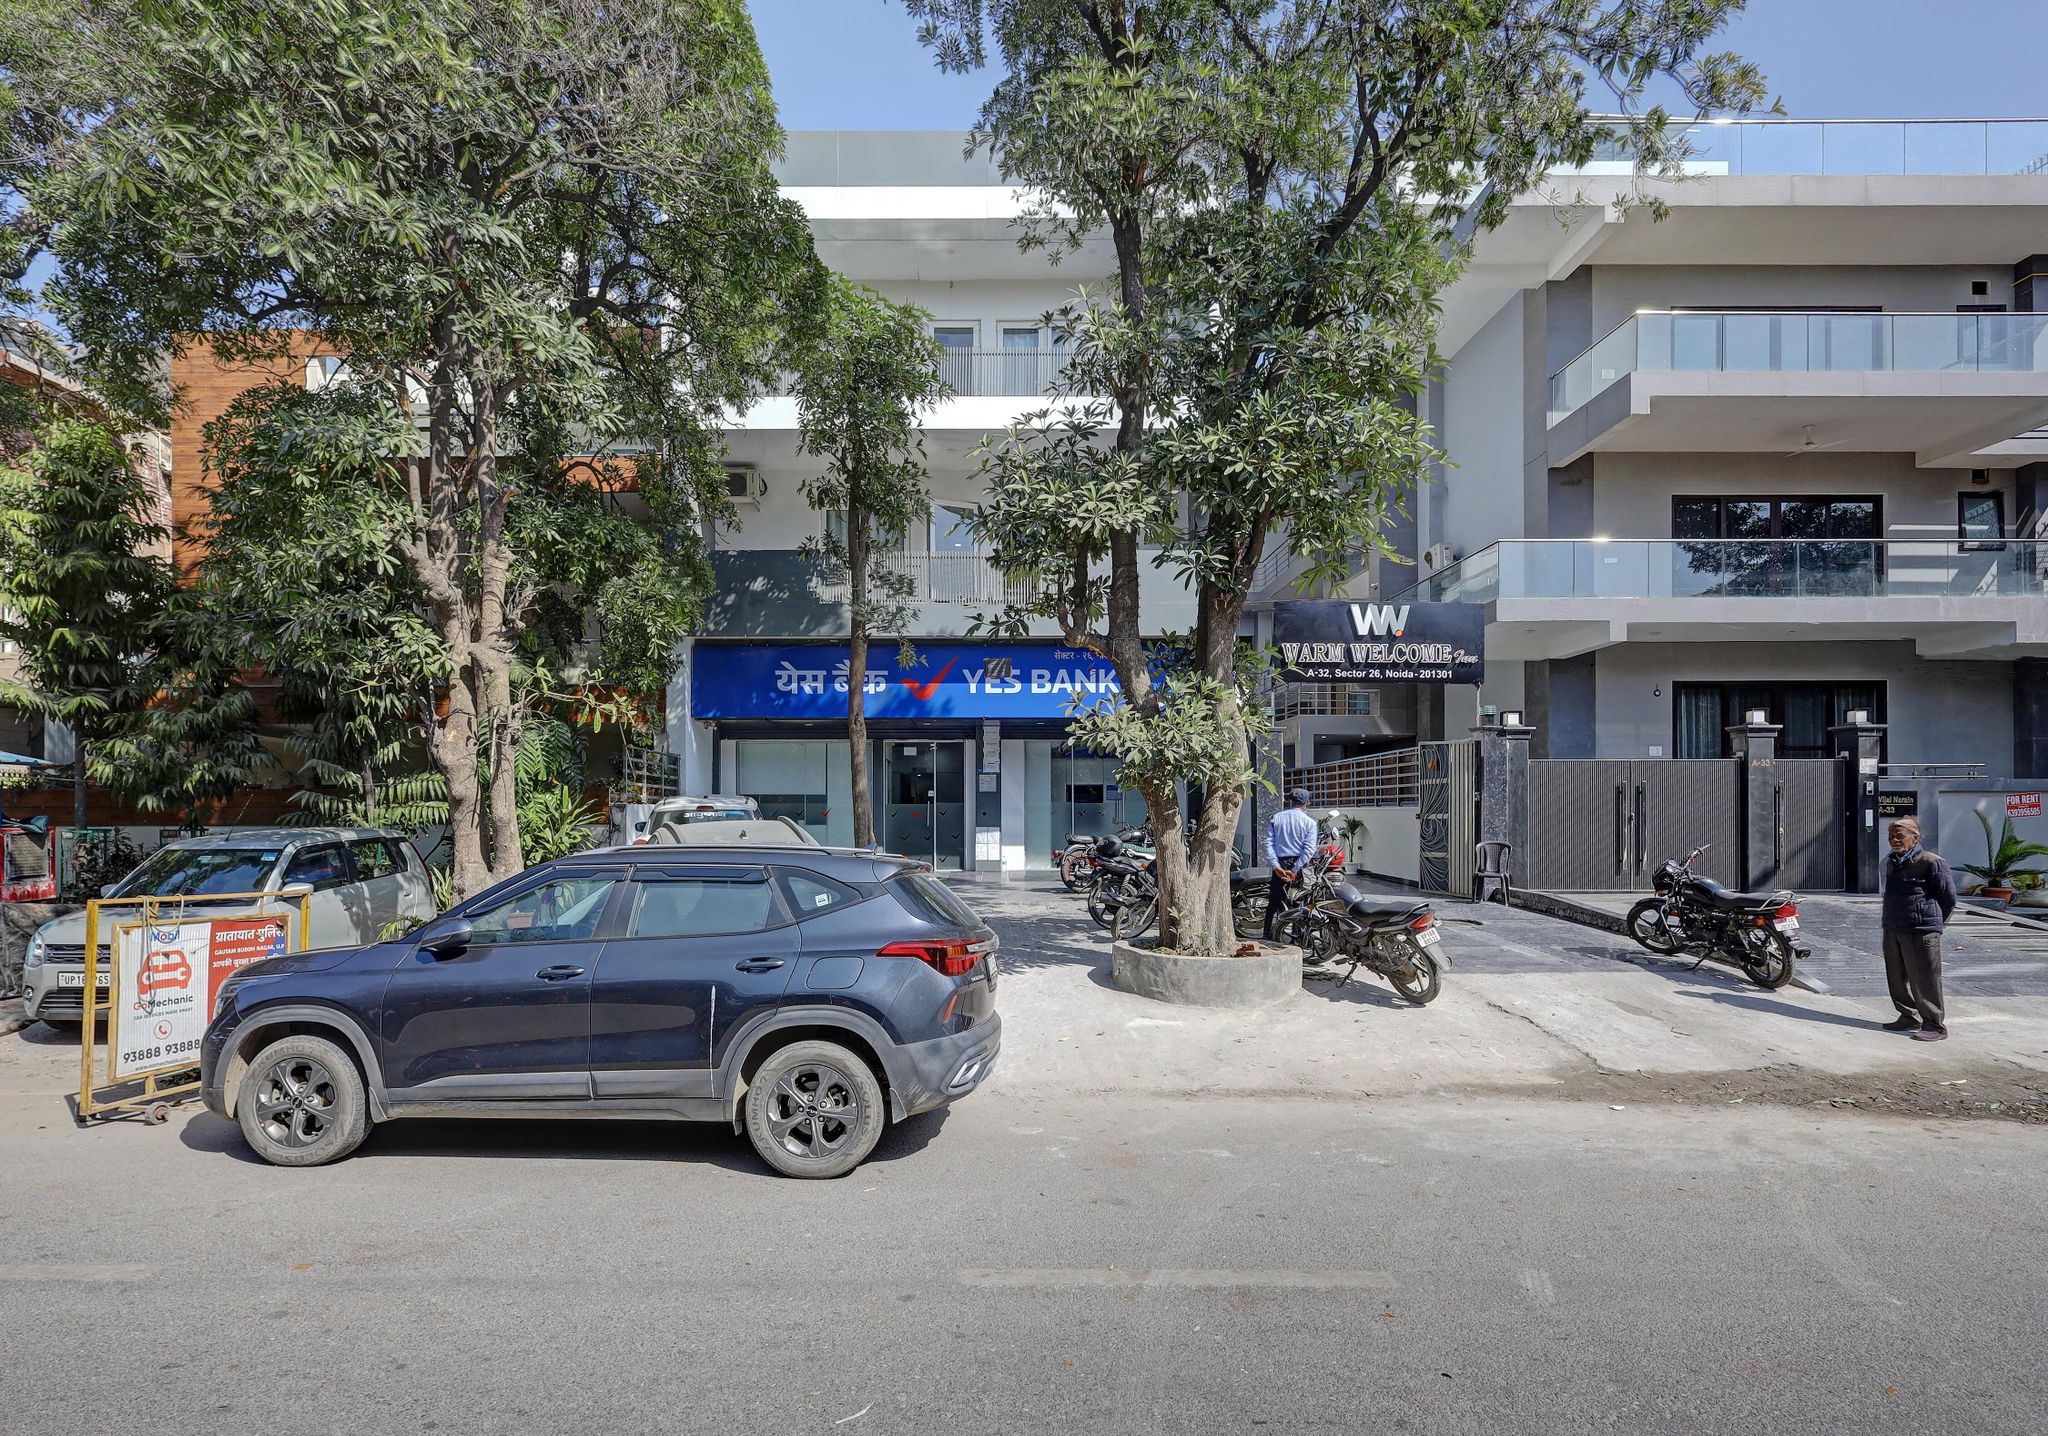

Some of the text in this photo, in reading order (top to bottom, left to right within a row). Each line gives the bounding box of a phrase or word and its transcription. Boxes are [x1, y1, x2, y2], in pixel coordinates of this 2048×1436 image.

[1053, 650, 1075, 660] सेक्टर
[1281, 642, 1480, 664] WARM WELCOME Inn
[775, 661, 827, 695] येस
[962, 668, 1120, 694] YES BANK
[1307, 669, 1332, 680] A-32,
[1335, 669, 1366, 679] Sector
[1369, 669, 1383, 680] 26,
[1751, 759, 1771, 768] A-33
[2006, 794, 2040, 805] FOR RENT
[133, 994, 194, 1011] GoMechanic
[123, 1039, 201, 1064] 93888 93888
[751, 1086, 767, 1142] KUMHO
